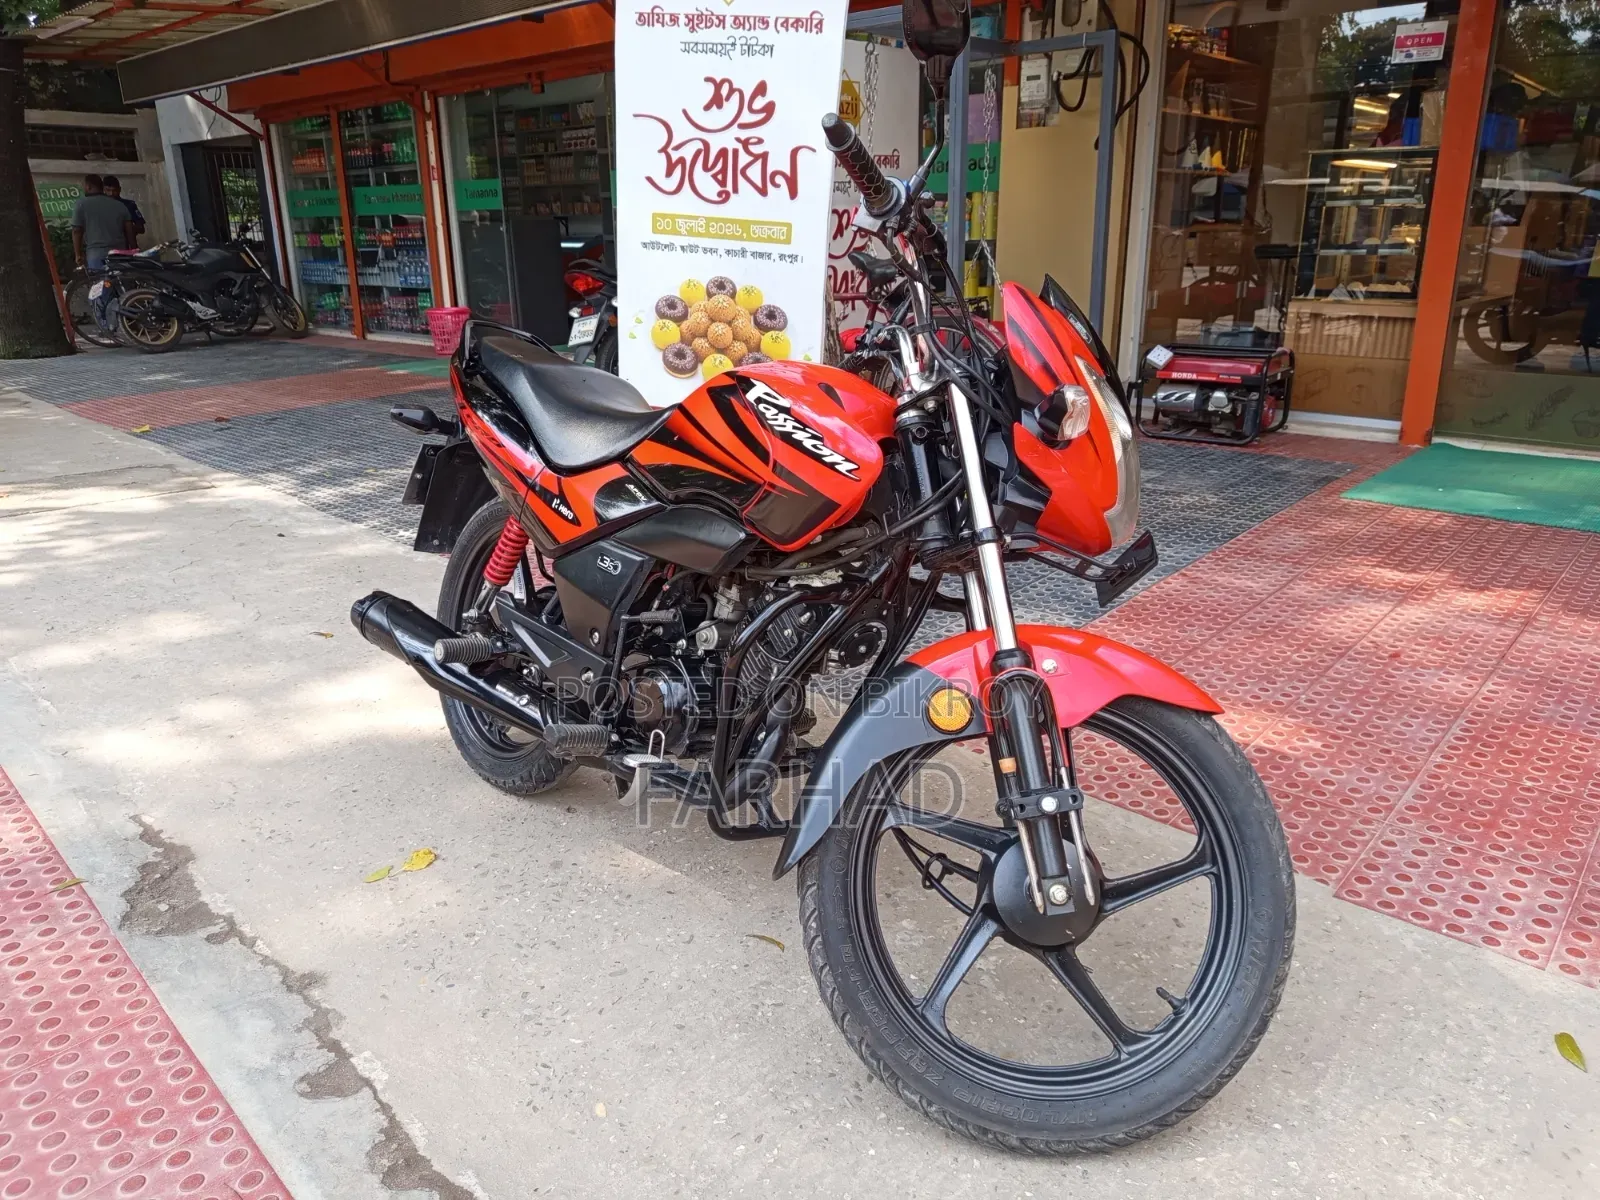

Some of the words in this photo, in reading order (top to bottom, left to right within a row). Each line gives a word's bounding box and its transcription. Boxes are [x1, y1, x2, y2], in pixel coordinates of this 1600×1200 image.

[684, 7, 726, 33] সুইটস
[774, 10, 825, 34] বেকারি
[739, 36, 775, 58] টাটকা
[1406, 36, 1433, 45] OPEN
[682, 76, 776, 133] শুভ
[633, 113, 817, 204] উদ্বোধন
[464, 187, 498, 199] Tamanna
[656, 217, 672, 230] ১০
[675, 217, 706, 235] জুলাই
[750, 225, 788, 240] শুক্রবার
[724, 247, 748, 259] কাচারী
[750, 250, 776, 263] বাজার,
[746, 378, 861, 480] Passion
